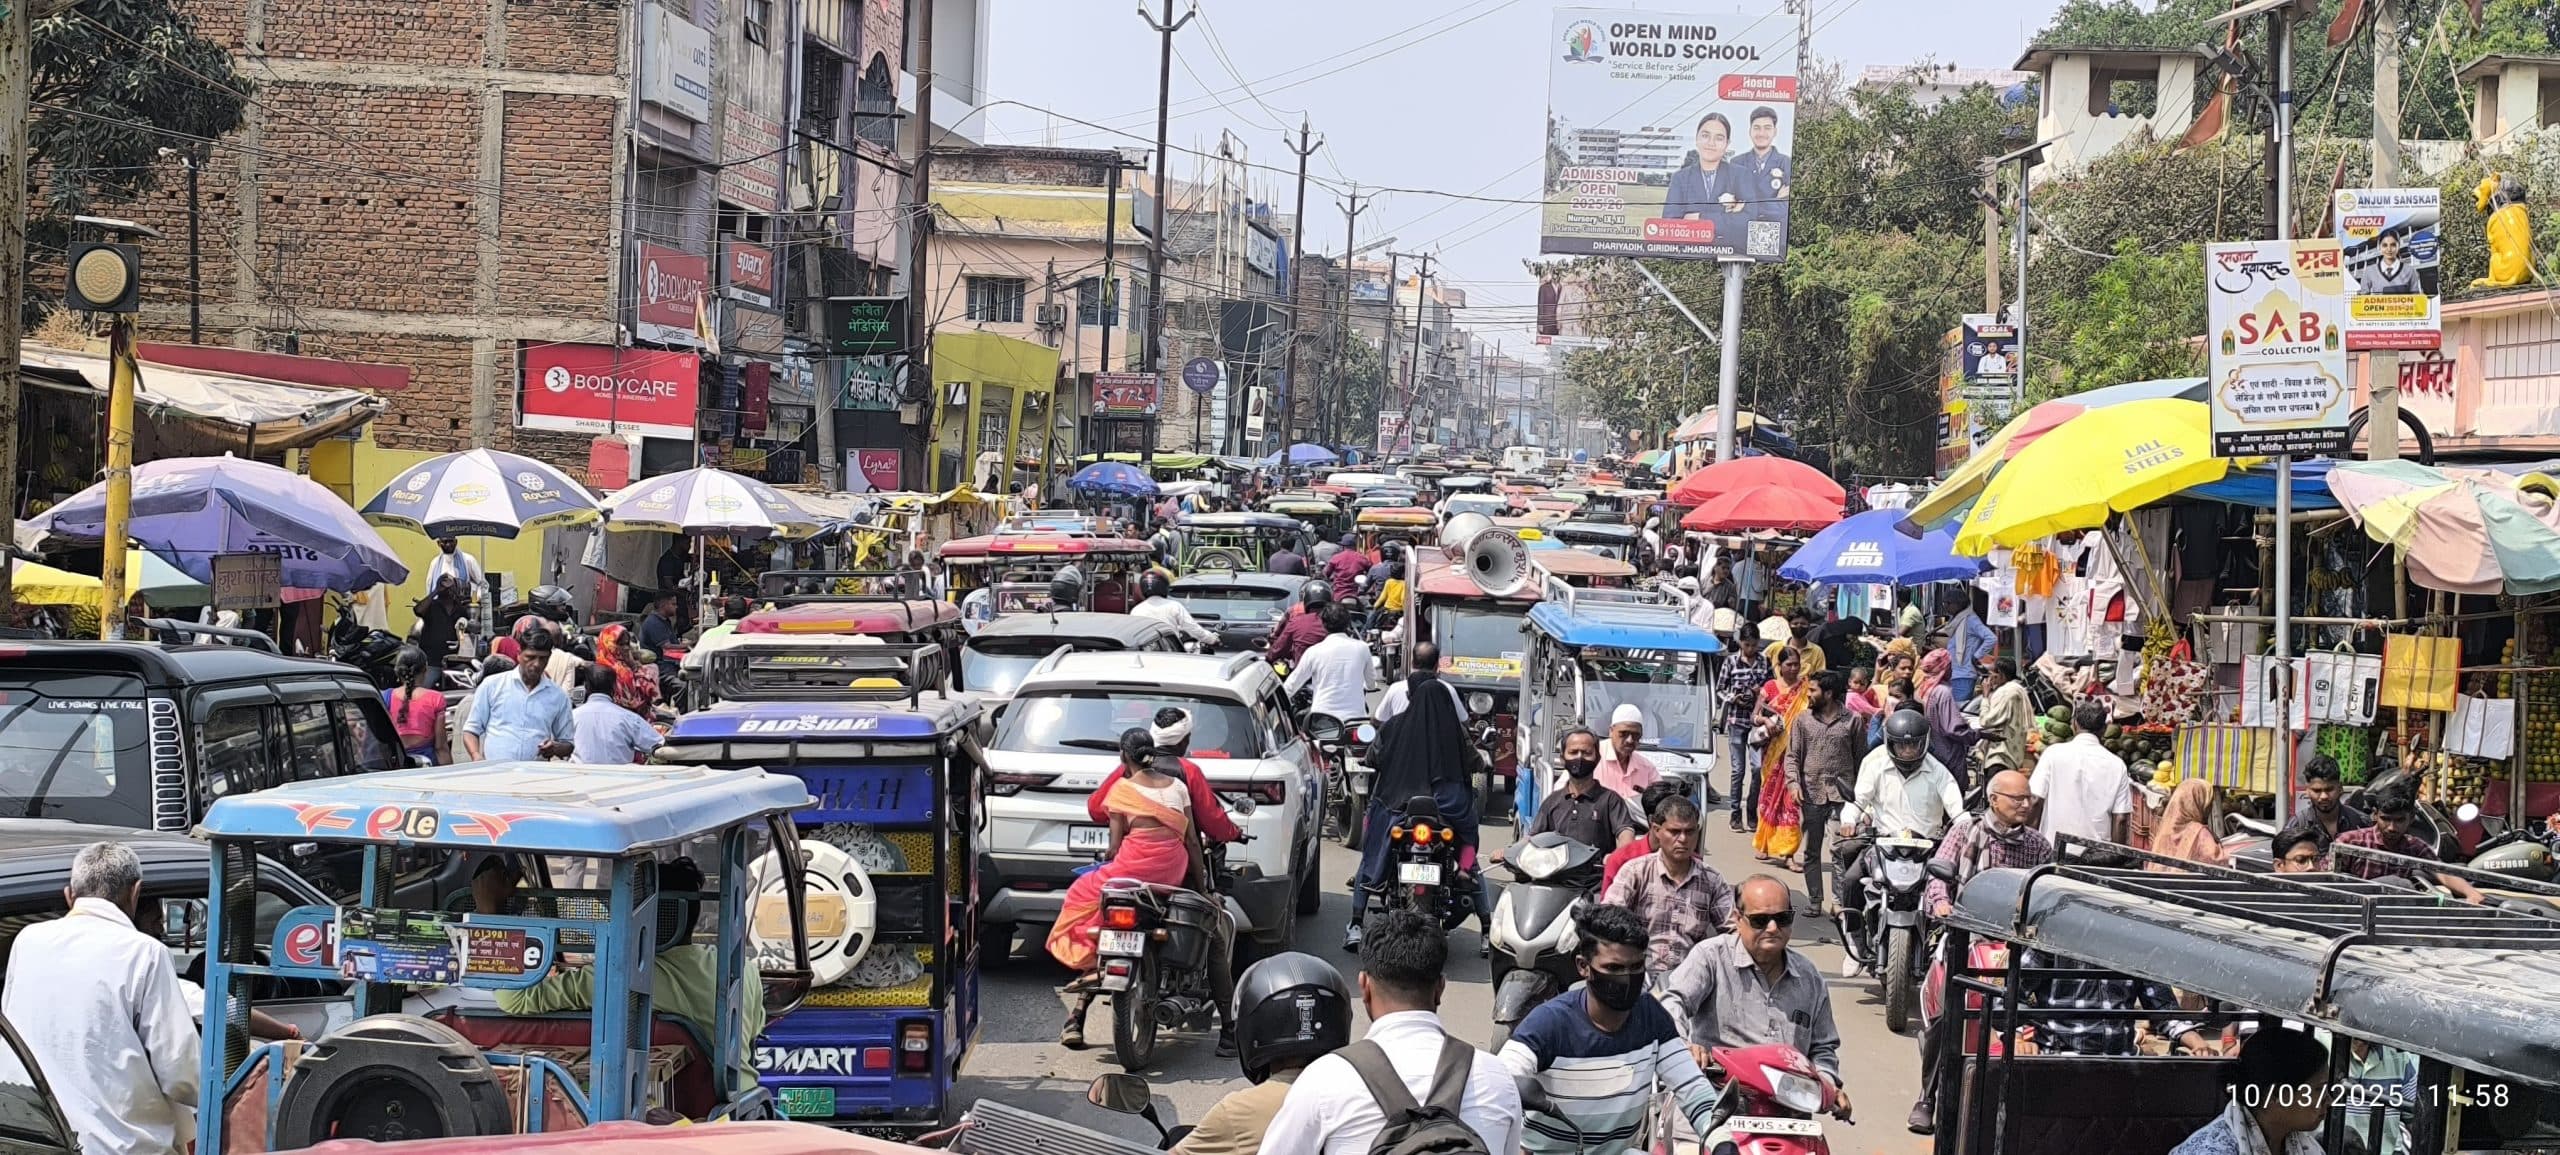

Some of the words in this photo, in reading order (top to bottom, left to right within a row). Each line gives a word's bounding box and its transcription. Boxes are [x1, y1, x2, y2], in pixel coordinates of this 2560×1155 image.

[1610, 23, 1661, 39] OPEN
[1668, 25, 1717, 40] MIND
[1609, 42, 1676, 58] WORLD
[1682, 44, 1760, 61] SCHOOL
[1743, 76, 1776, 88] Hostel
[1756, 90, 1790, 99] Available
[1560, 168, 1637, 182] ADMISSION
[1580, 184, 1616, 194] OPEN
[2358, 196, 2391, 205] ANJUM
[2394, 195, 2438, 204] SANSKAR
[2345, 216, 2384, 226] ENROLL
[2352, 228, 2374, 236] NOW
[1593, 242, 1644, 252] DHARIYADIH,
[1647, 244, 1681, 253] GIRIDIH,
[1682, 245, 1734, 254] JHARKHAND
[736, 251, 766, 276] sparx
[2364, 296, 2414, 304] ADMISSION
[851, 302, 884, 316] कविता
[2364, 304, 2384, 312] OPEN
[2239, 308, 2320, 344] SAB
[2262, 346, 2320, 356] COLLECTION
[574, 374, 678, 397] BODYCARE
[576, 420, 606, 428] SHARDA
[2125, 439, 2164, 458] LALL
[863, 455, 891, 475] Lyra
[2124, 447, 2184, 474] STEELS
[392, 489, 424, 502] Rotary
[1848, 542, 1879, 552] LALL
[1836, 556, 1882, 566] STEELS
[48, 701, 67, 709] LIVE
[100, 701, 119, 709] LIVE
[737, 714, 876, 732] BADSHAH
[754, 1046, 857, 1076] SMART
